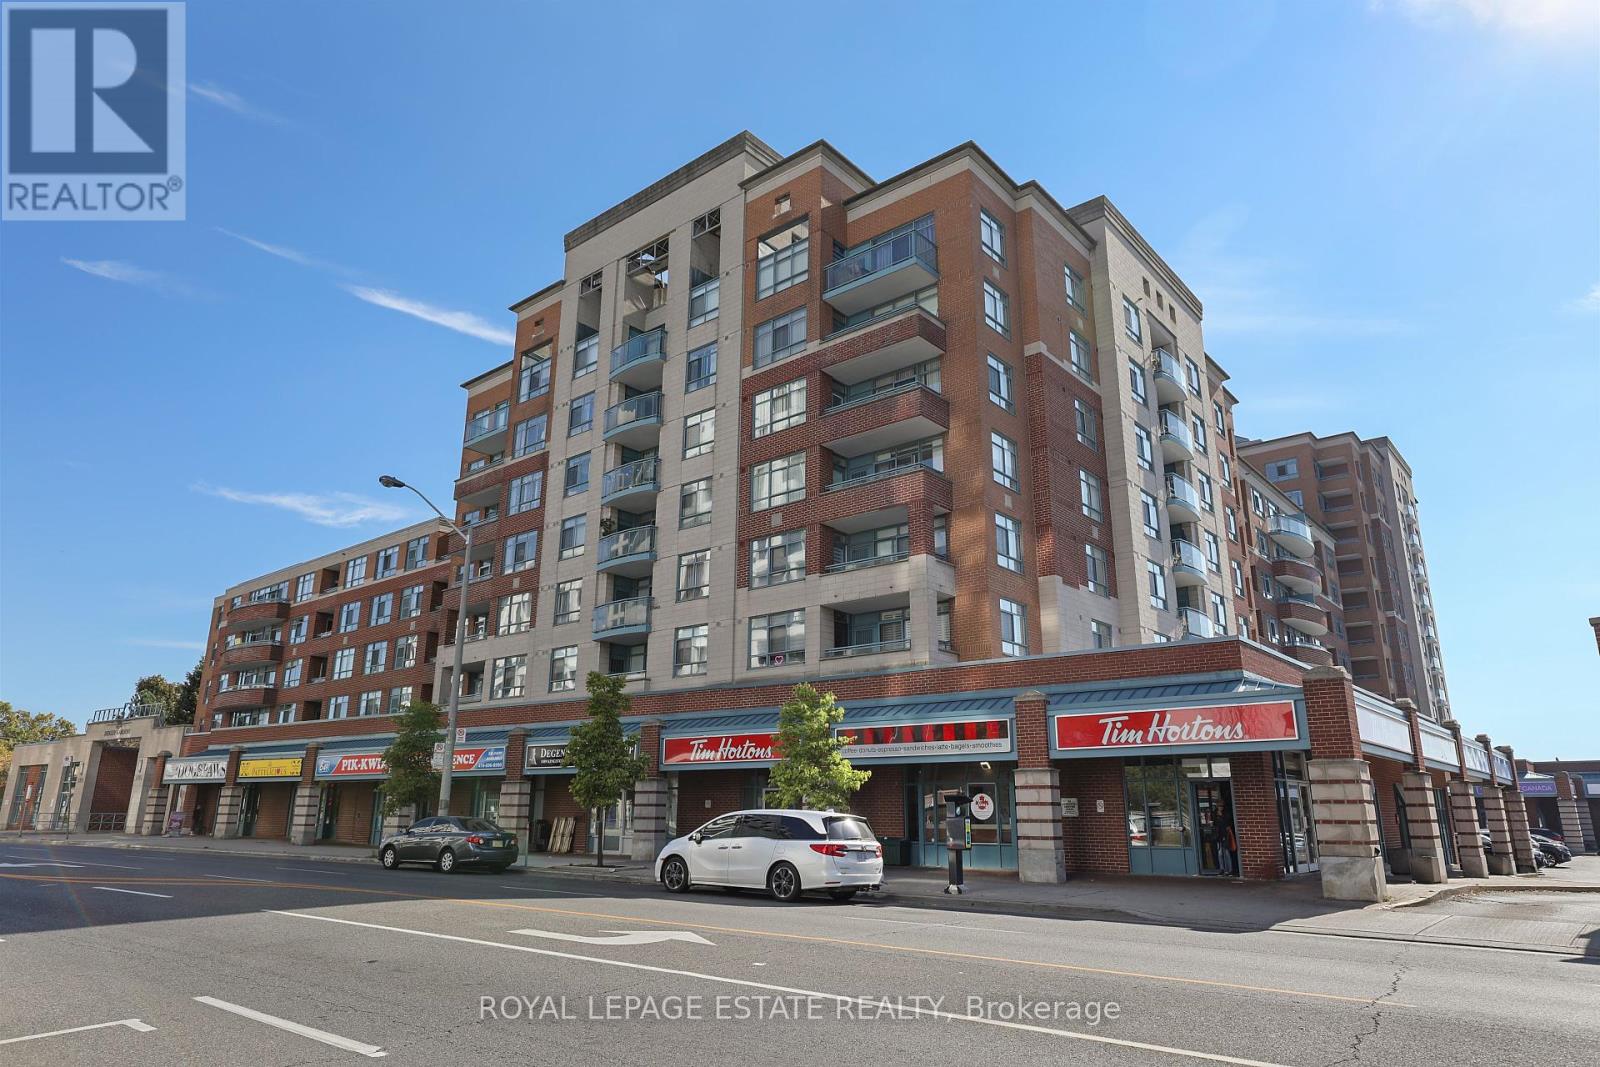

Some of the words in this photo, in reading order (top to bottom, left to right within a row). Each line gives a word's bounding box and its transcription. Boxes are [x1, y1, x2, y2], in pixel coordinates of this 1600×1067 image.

[1099, 715, 1143, 745] Tim
[1147, 712, 1244, 742] Hortons
[689, 739, 716, 761] Tim
[717, 737, 772, 760] Hortons
